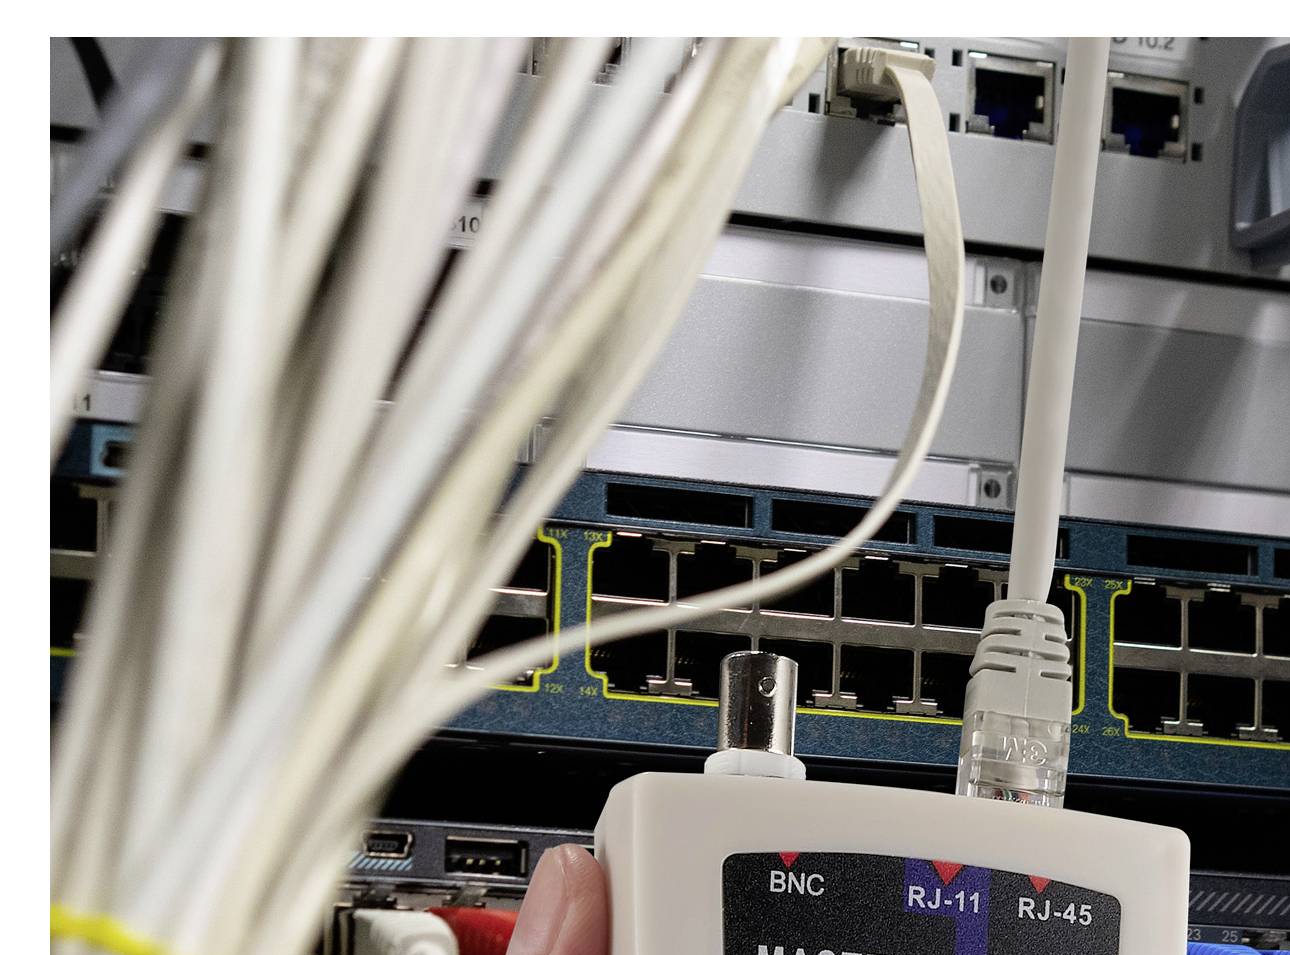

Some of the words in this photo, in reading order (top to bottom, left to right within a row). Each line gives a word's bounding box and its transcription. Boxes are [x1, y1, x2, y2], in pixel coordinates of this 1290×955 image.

[770, 870, 825, 896] BNC
[908, 885, 979, 913] RJ-11
[1018, 897, 1093, 926] RJ-45
[1221, 929, 1239, 943] 25
